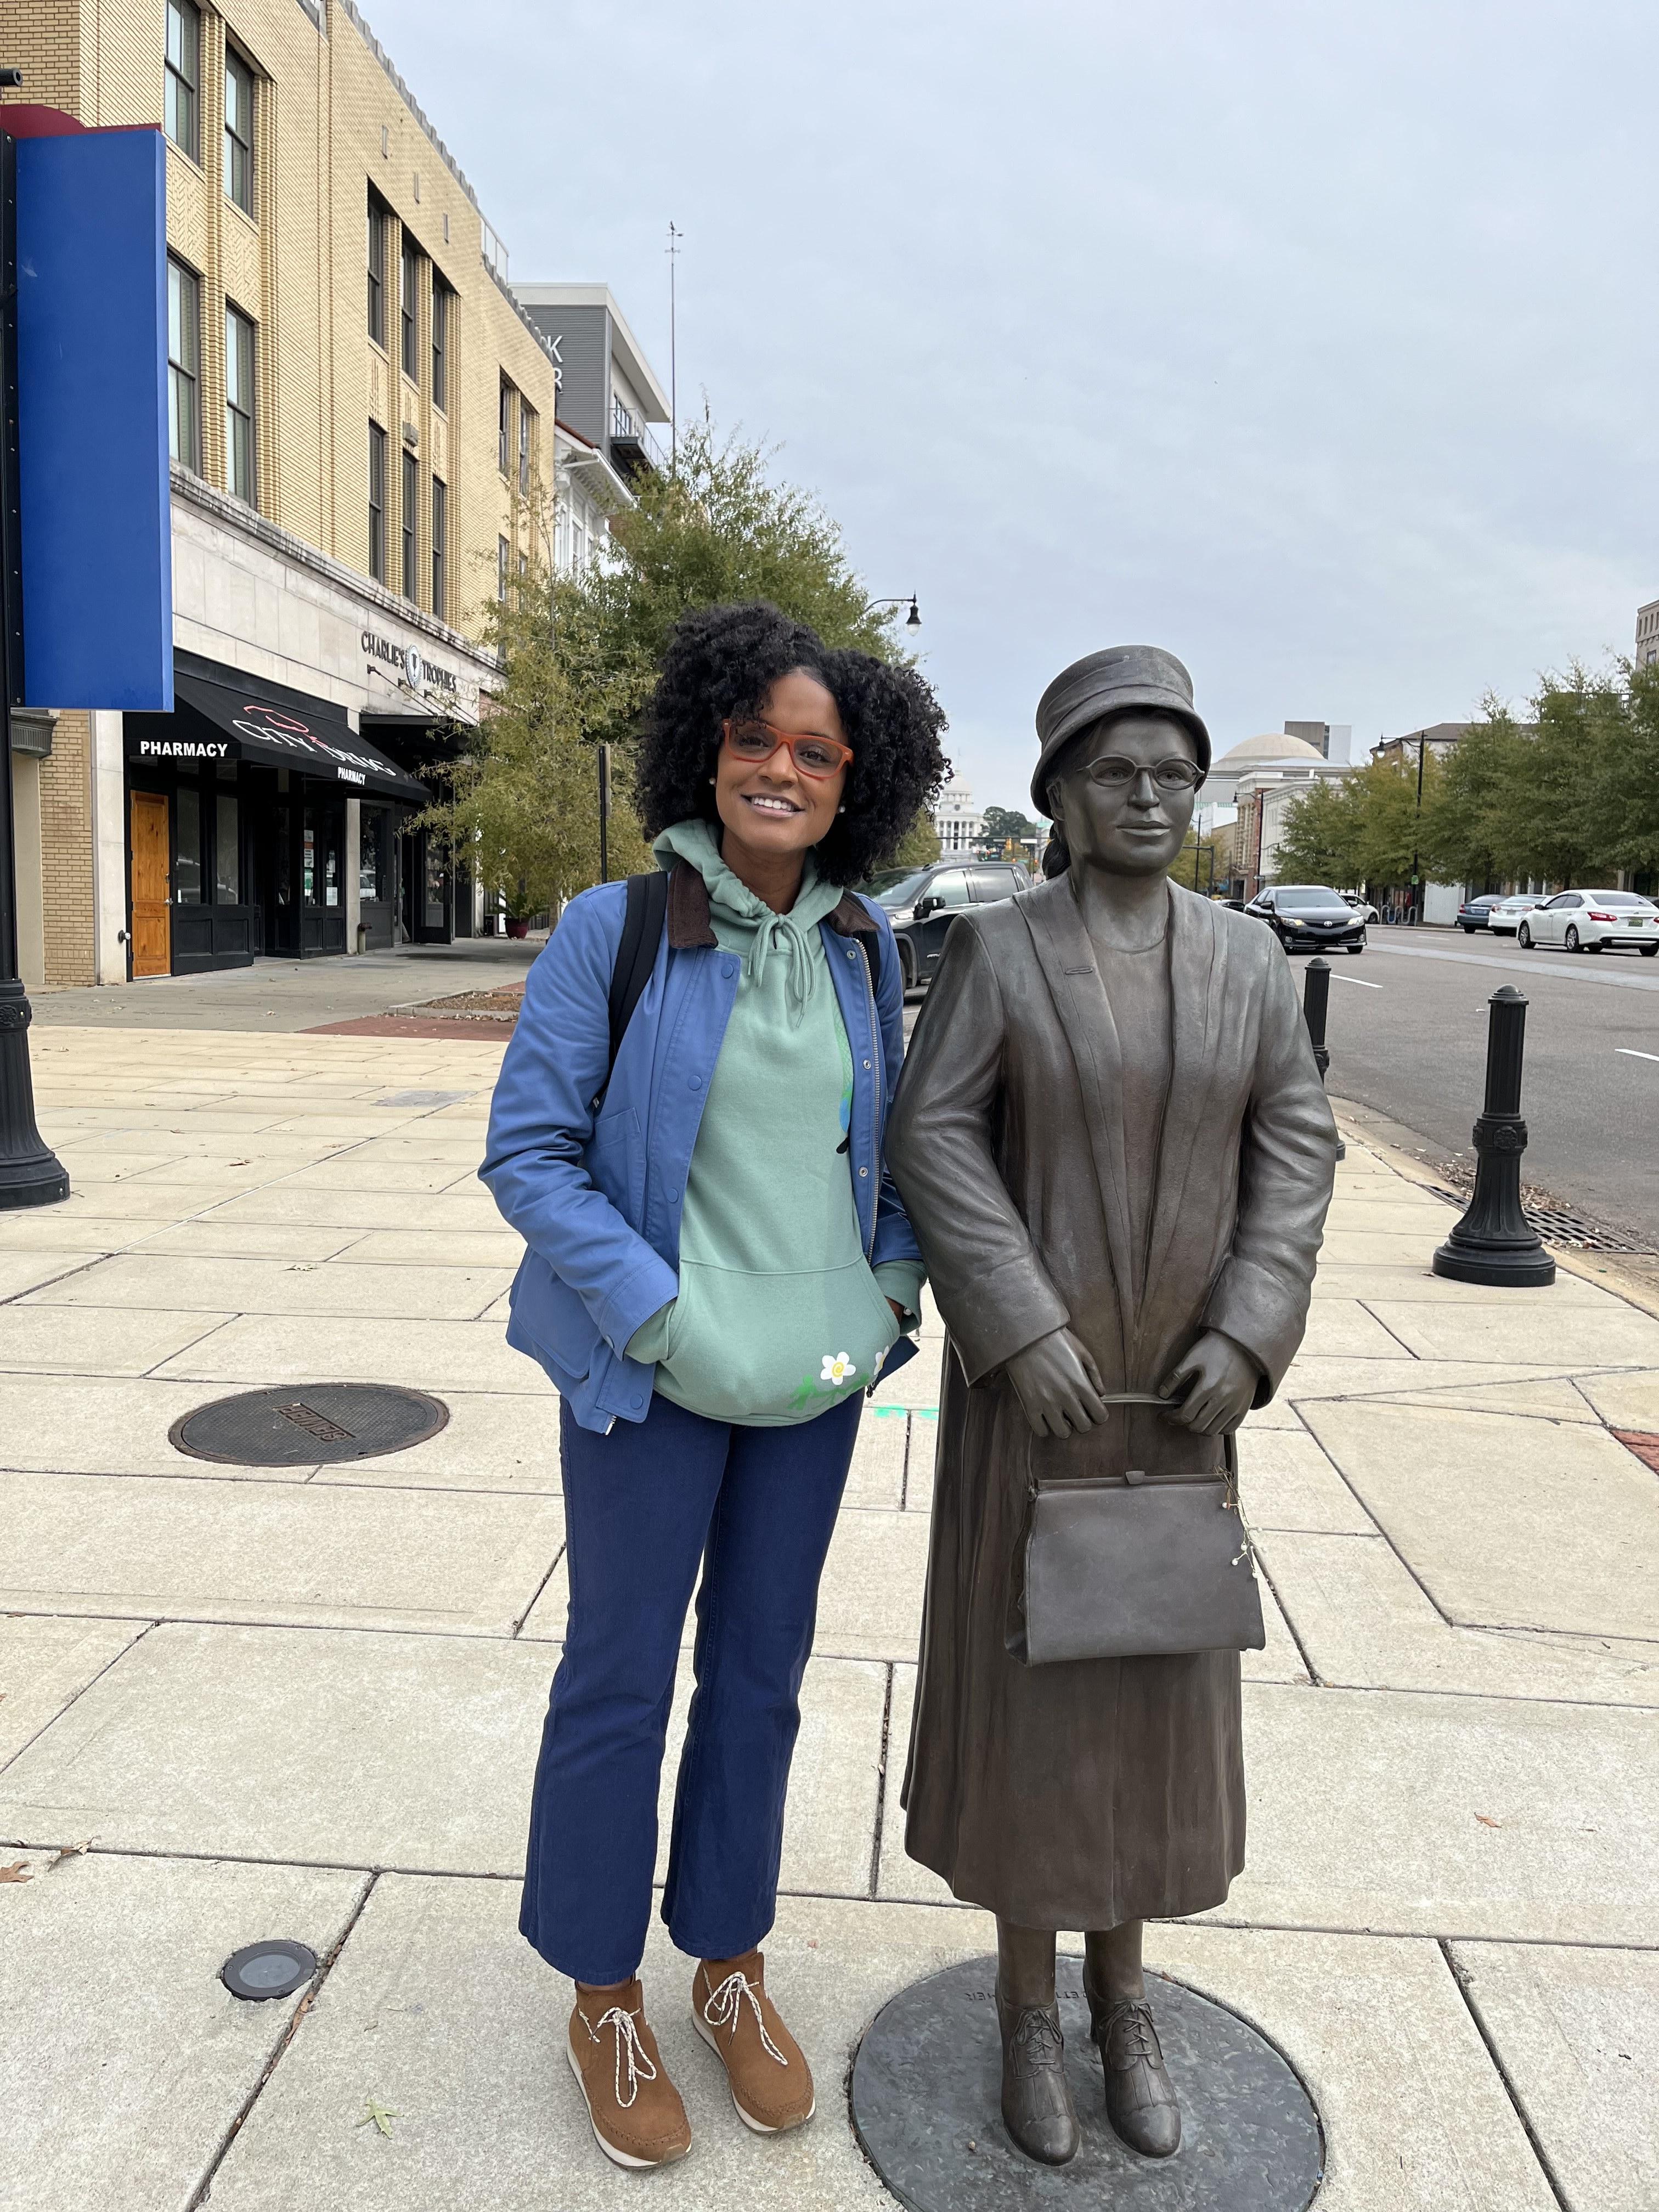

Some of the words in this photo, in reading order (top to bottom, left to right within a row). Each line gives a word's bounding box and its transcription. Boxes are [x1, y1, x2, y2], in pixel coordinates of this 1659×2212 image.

[361, 631, 405, 669] CHARLIE'S
[421, 659, 456, 693] TROPHIES
[140, 741, 228, 757] PHARMACY
[233, 719, 317, 752] CITY
[312, 740, 397, 776] DRUG
[337, 766, 366, 786] PHARMACY
[279, 1406, 347, 1442] SEWER
